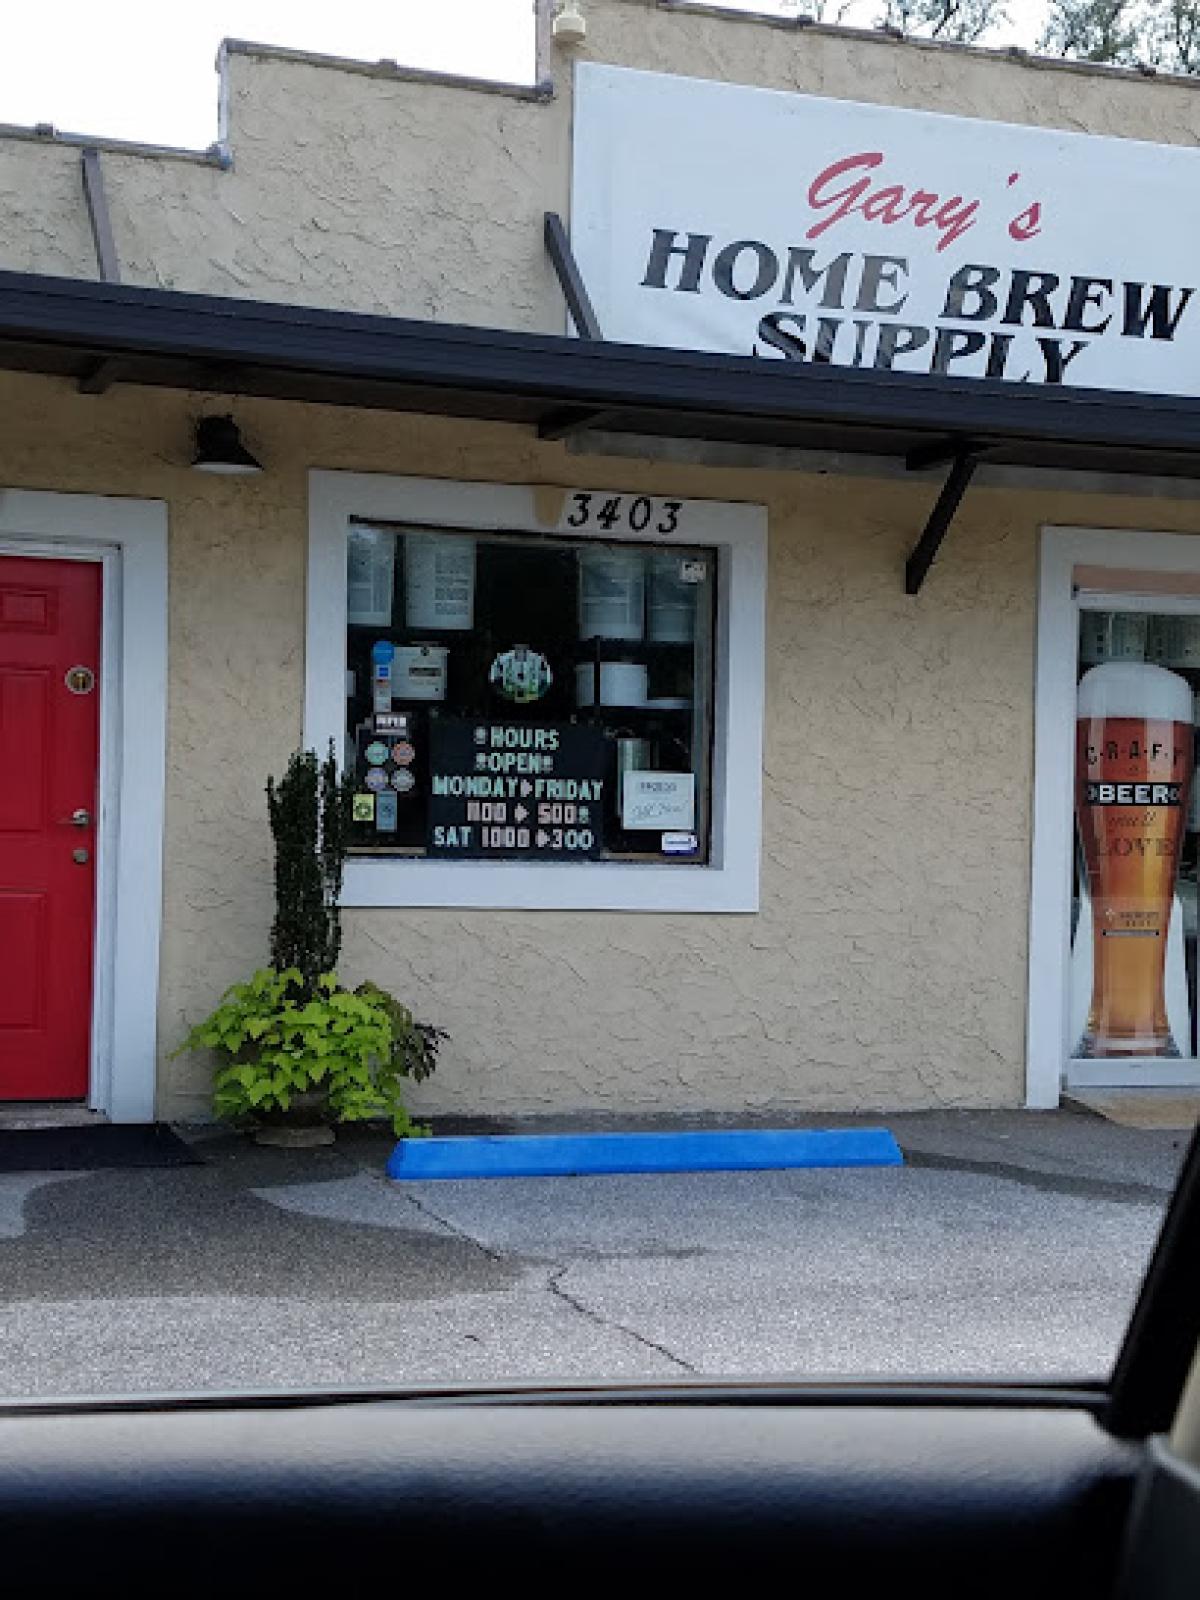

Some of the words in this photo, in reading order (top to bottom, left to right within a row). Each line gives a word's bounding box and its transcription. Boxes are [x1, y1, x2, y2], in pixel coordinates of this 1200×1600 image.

[807, 152, 1042, 252] Gary's
[639, 228, 911, 316] HOME
[938, 263, 1197, 342] BREW
[753, 311, 1091, 385] SUPPLY
[567, 493, 683, 534] 3403
[490, 726, 560, 751] HOURS
[488, 752, 541, 775] OPEN
[431, 775, 519, 799] MONDAY
[534, 778, 604, 804] FRIDAY
[1099, 783, 1170, 804] BEER
[537, 802, 577, 825] 500
[434, 825, 472, 849] SAT
[481, 826, 531, 850] 1000
[552, 828, 595, 851] 300
[1094, 836, 1176, 857] LOVE
